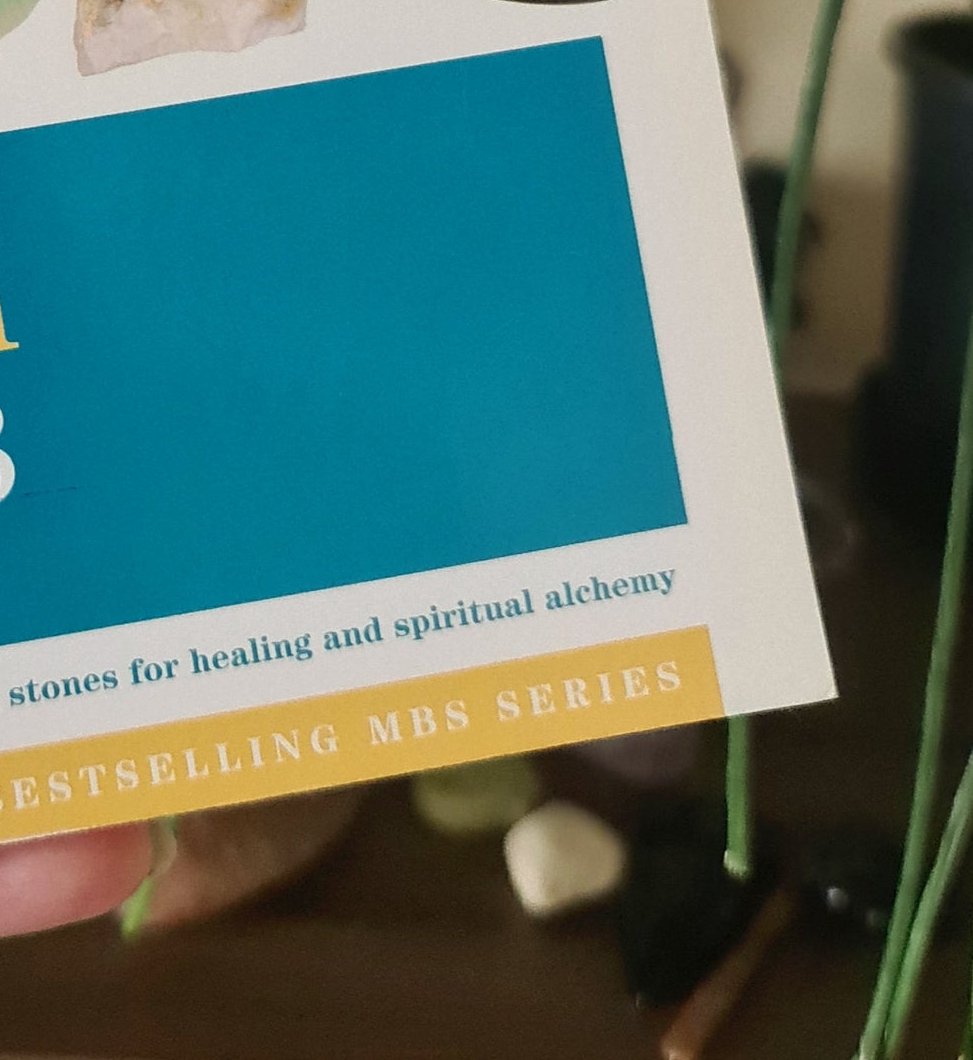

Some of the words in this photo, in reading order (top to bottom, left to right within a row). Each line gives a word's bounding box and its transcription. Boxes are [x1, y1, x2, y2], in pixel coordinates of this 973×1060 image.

[9, 666, 119, 707] stones
[129, 655, 179, 687] for
[189, 630, 313, 675] healing
[323, 617, 383, 652] and
[393, 589, 534, 642] spiritual
[545, 567, 676, 611] alchemy
[368, 699, 470, 746] MBS
[496, 659, 683, 723] SERIES
